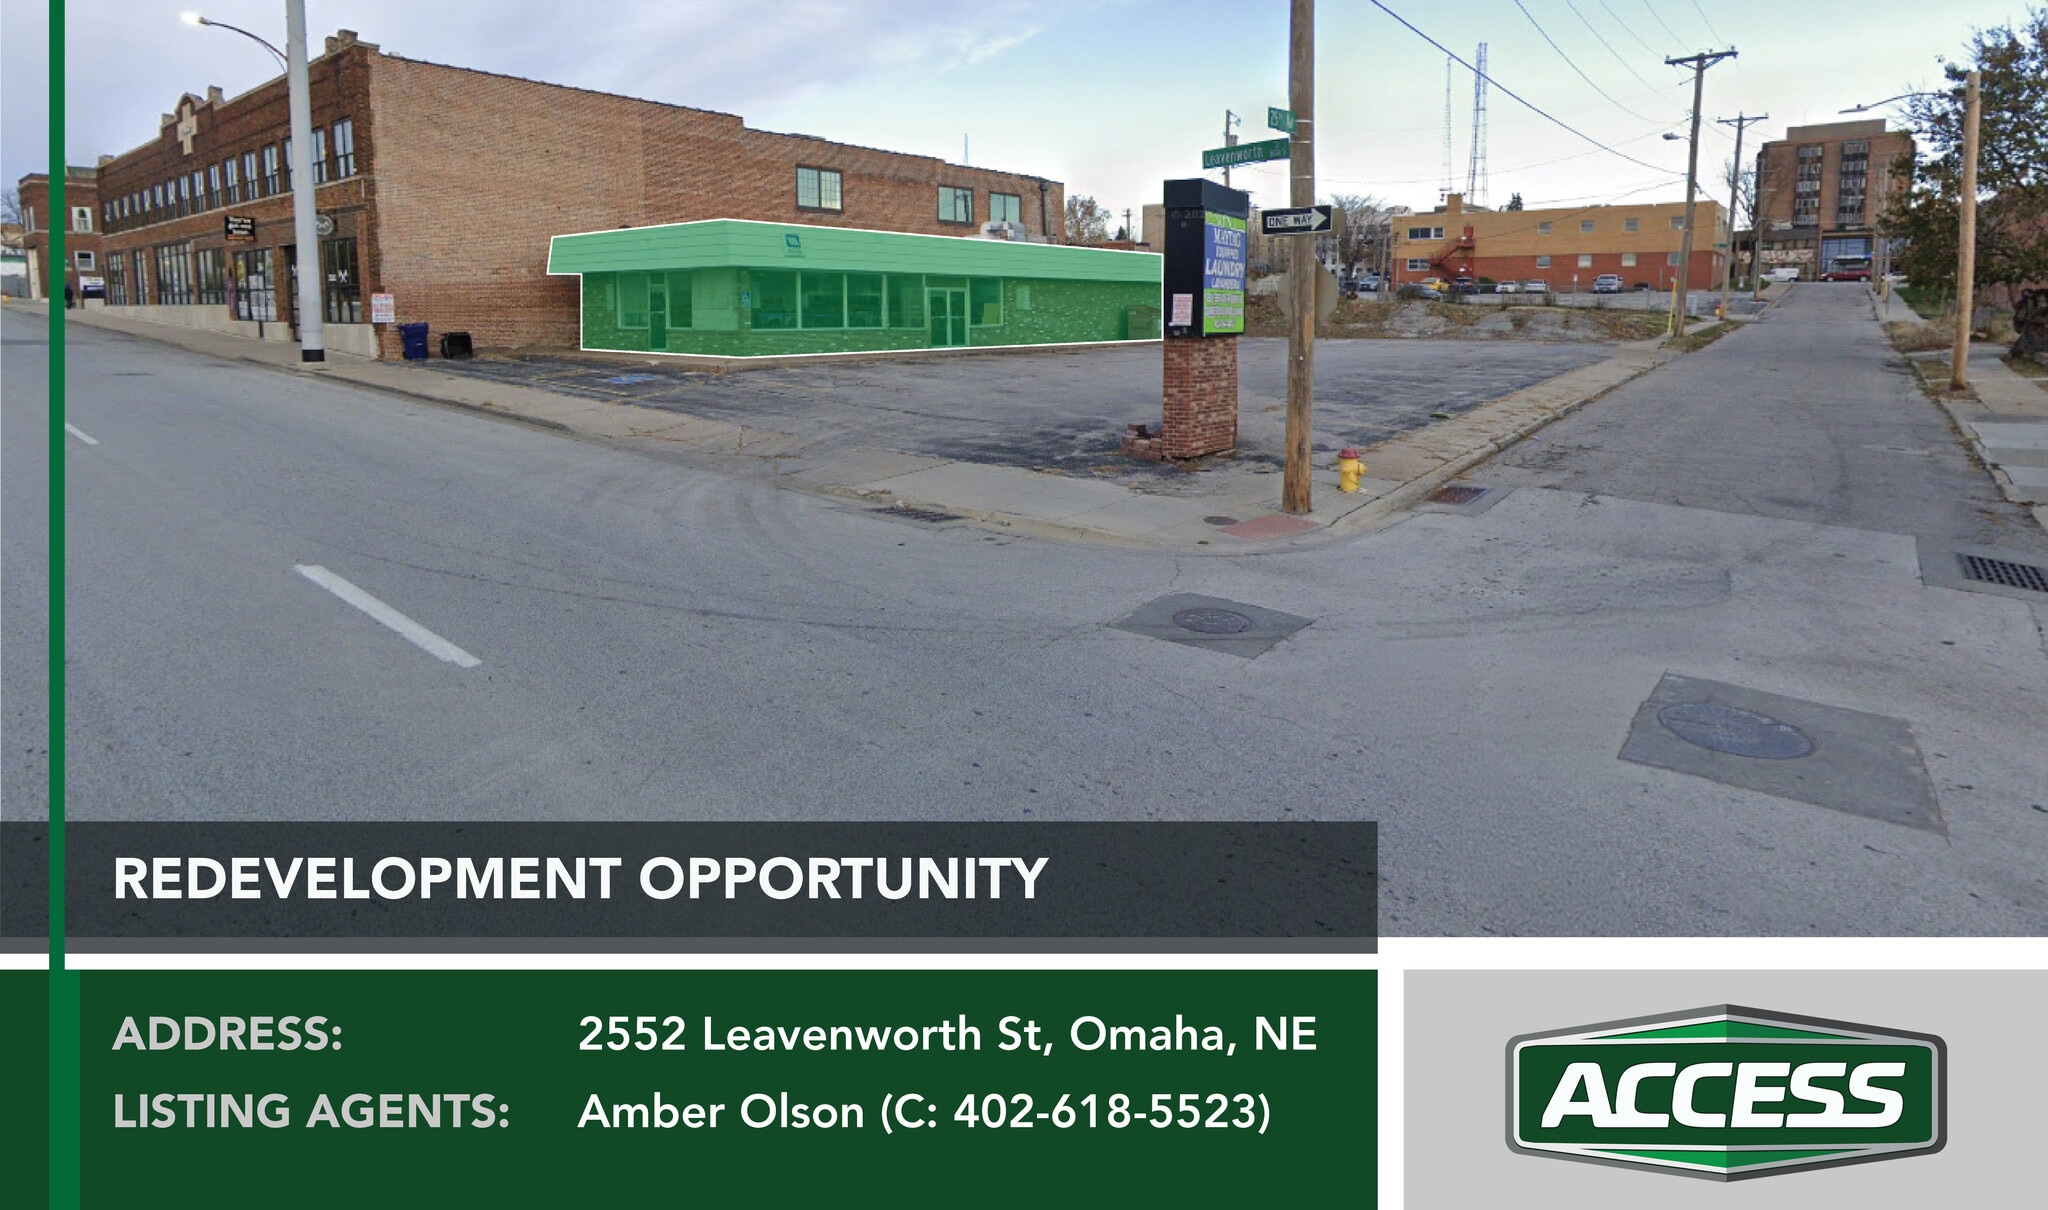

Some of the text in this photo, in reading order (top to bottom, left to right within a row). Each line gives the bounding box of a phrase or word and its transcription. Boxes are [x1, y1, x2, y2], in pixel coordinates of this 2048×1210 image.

[1205, 145, 1263, 166] Leavenworth
[1267, 214, 1312, 227] ONE WAY
[1205, 258, 1245, 278] LAUNDRY
